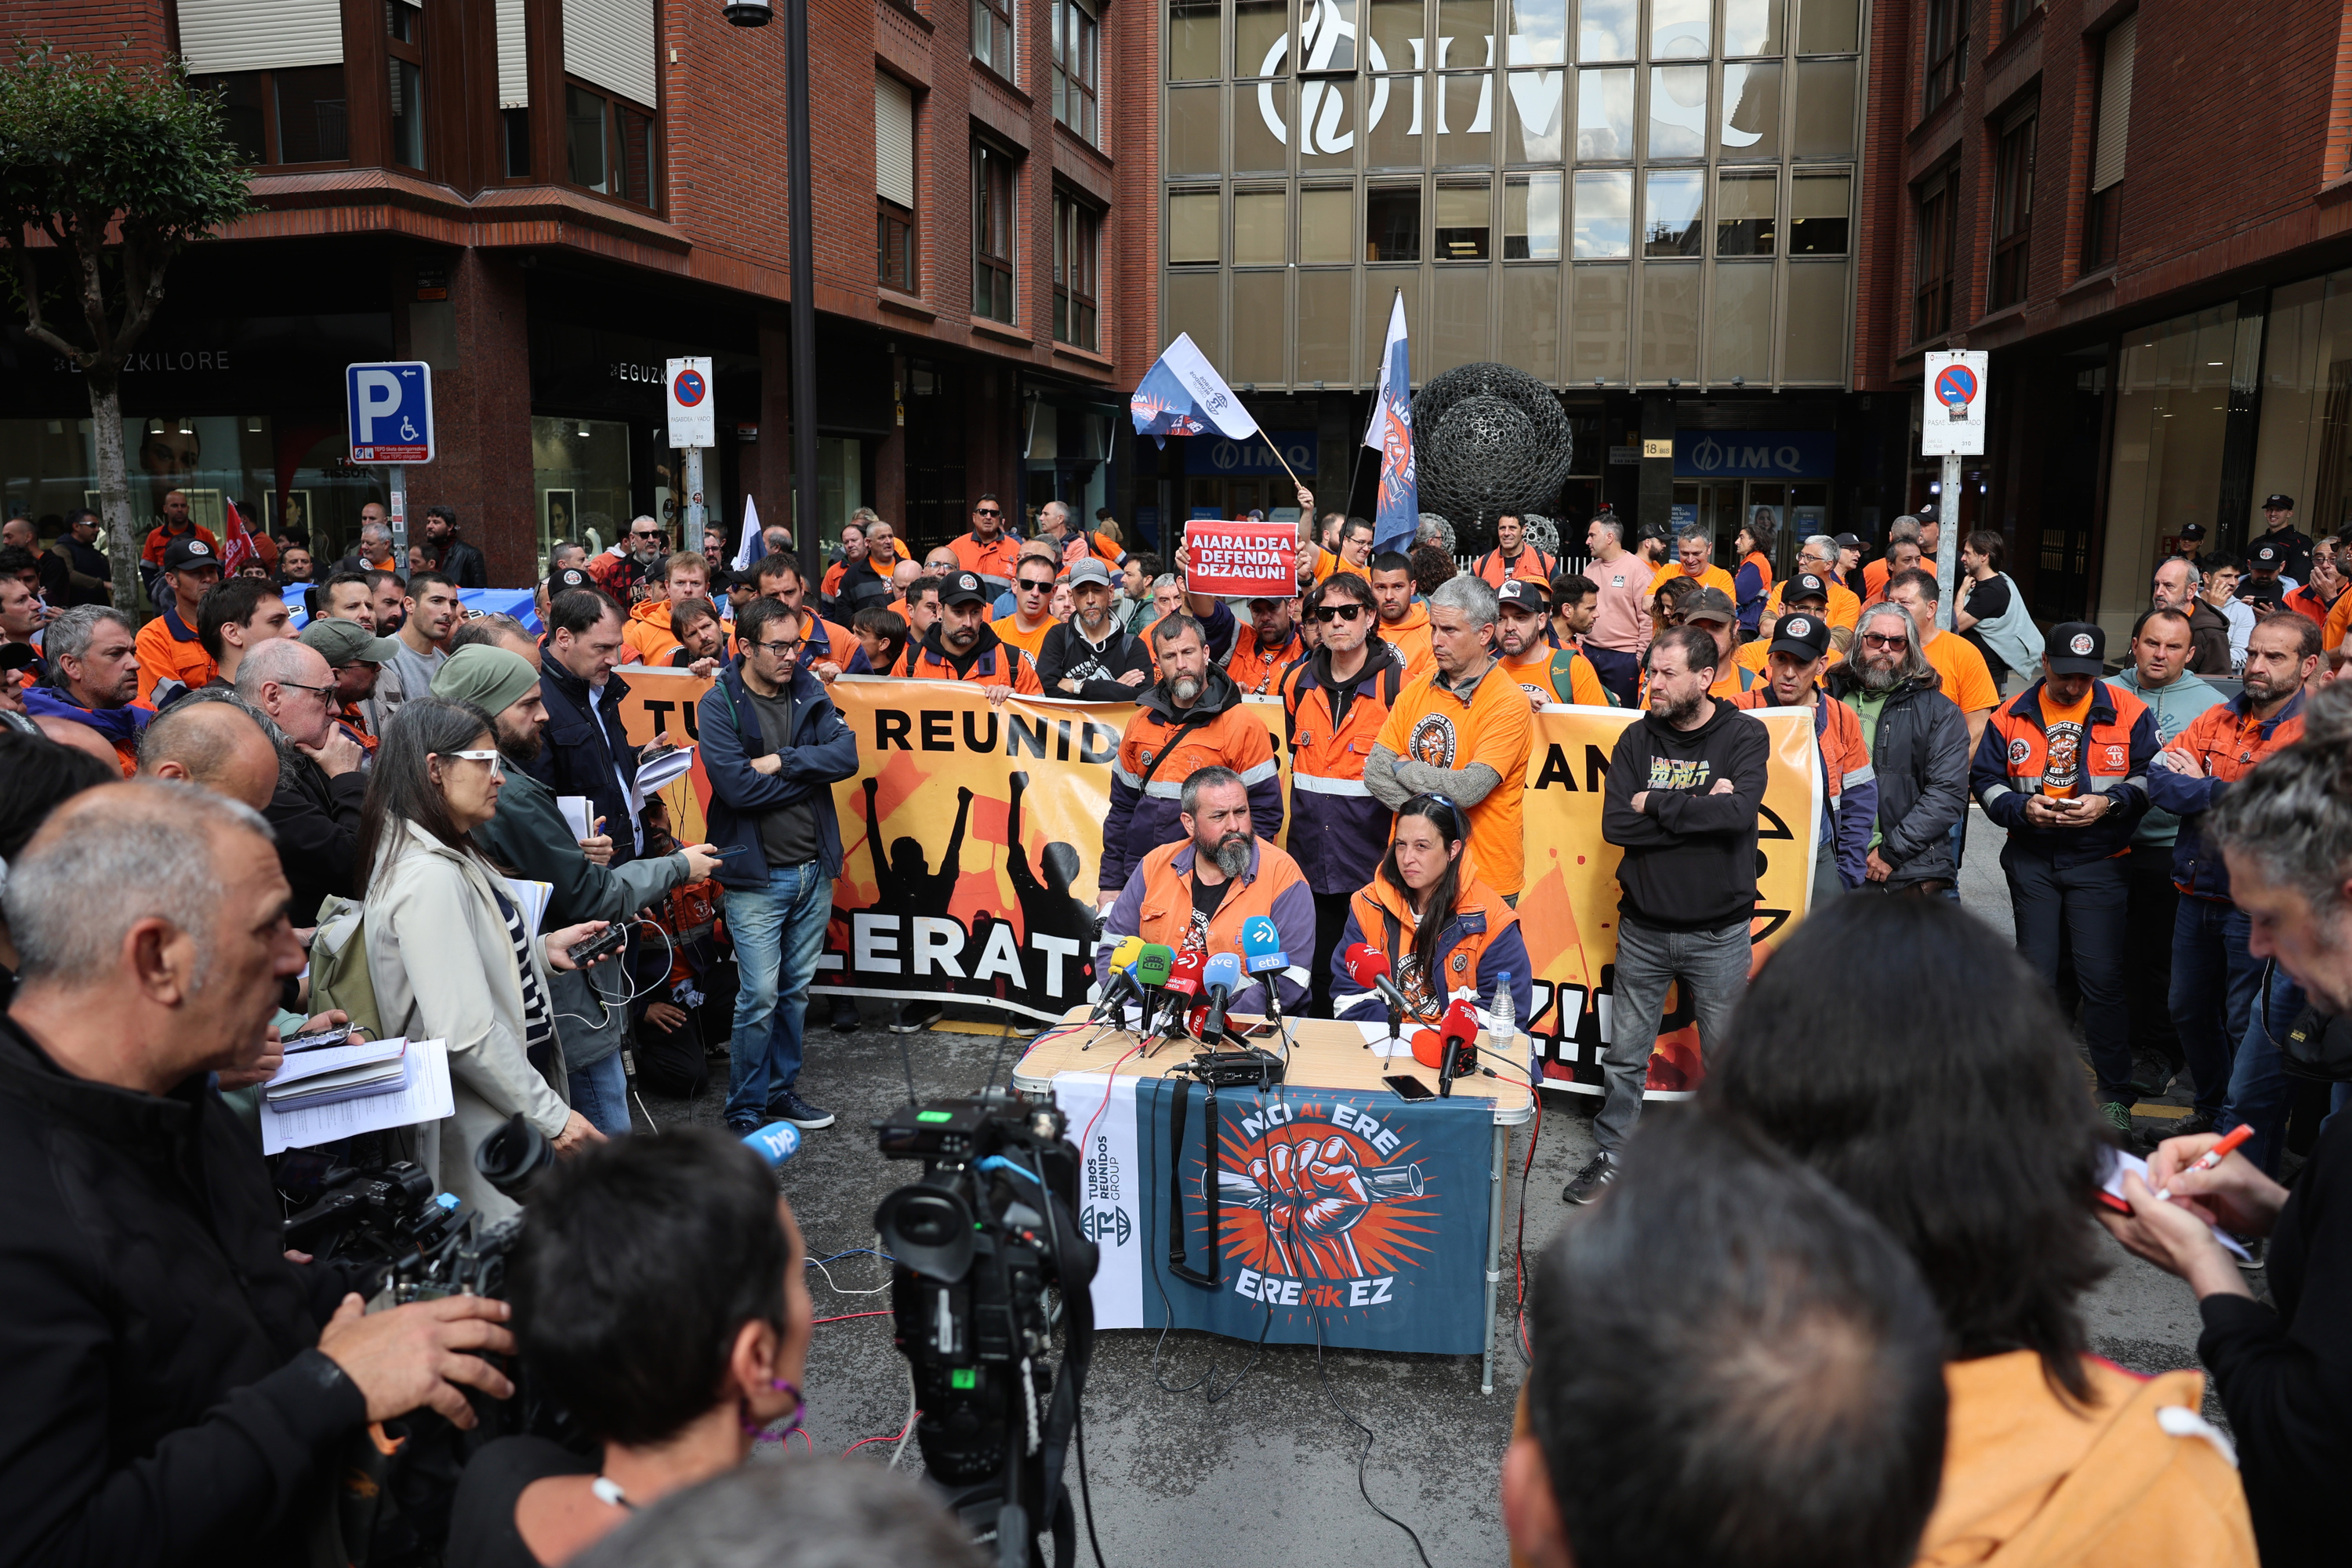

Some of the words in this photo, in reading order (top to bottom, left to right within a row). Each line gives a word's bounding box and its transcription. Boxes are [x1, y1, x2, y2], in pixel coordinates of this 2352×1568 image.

[1406, 20, 1763, 147] IMQ
[71, 350, 230, 373] EZKILORE
[357, 369, 402, 443] P
[1391, 401, 1411, 426] NO
[1243, 445, 1313, 471] IMQ
[1645, 444, 1657, 454] 18
[1726, 445, 1802, 473] IMQ
[321, 467, 368, 479] TISSOT
[1191, 534, 1292, 551] AIARALDEA
[1201, 550, 1283, 565] DEFENDA
[1197, 563, 1287, 580] DEZAGUN!
[1410, 726, 1421, 753] TUBOS
[1444, 721, 1454, 763] BORROKAN
[2050, 735, 2061, 743] NO
[1650, 755, 1690, 774] BACK
[2107, 751, 2124, 760] TR
[1646, 779, 1669, 789] THE
[1667, 770, 1710, 789] PAST
[1650, 771, 1669, 781] TO
[1210, 957, 1233, 968] tve
[1258, 955, 1280, 969] etb
[1192, 1014, 1203, 1033] rne
[1240, 1102, 1294, 1138] NO
[1298, 1103, 1327, 1119] AL
[1330, 1103, 1401, 1156] ERE
[1098, 1135, 1109, 1200] REUNIDOS
[1087, 1157, 1098, 1200] TUBOS
[1109, 1156, 1120, 1201] GROUP
[1348, 1276, 1394, 1307] EZ
